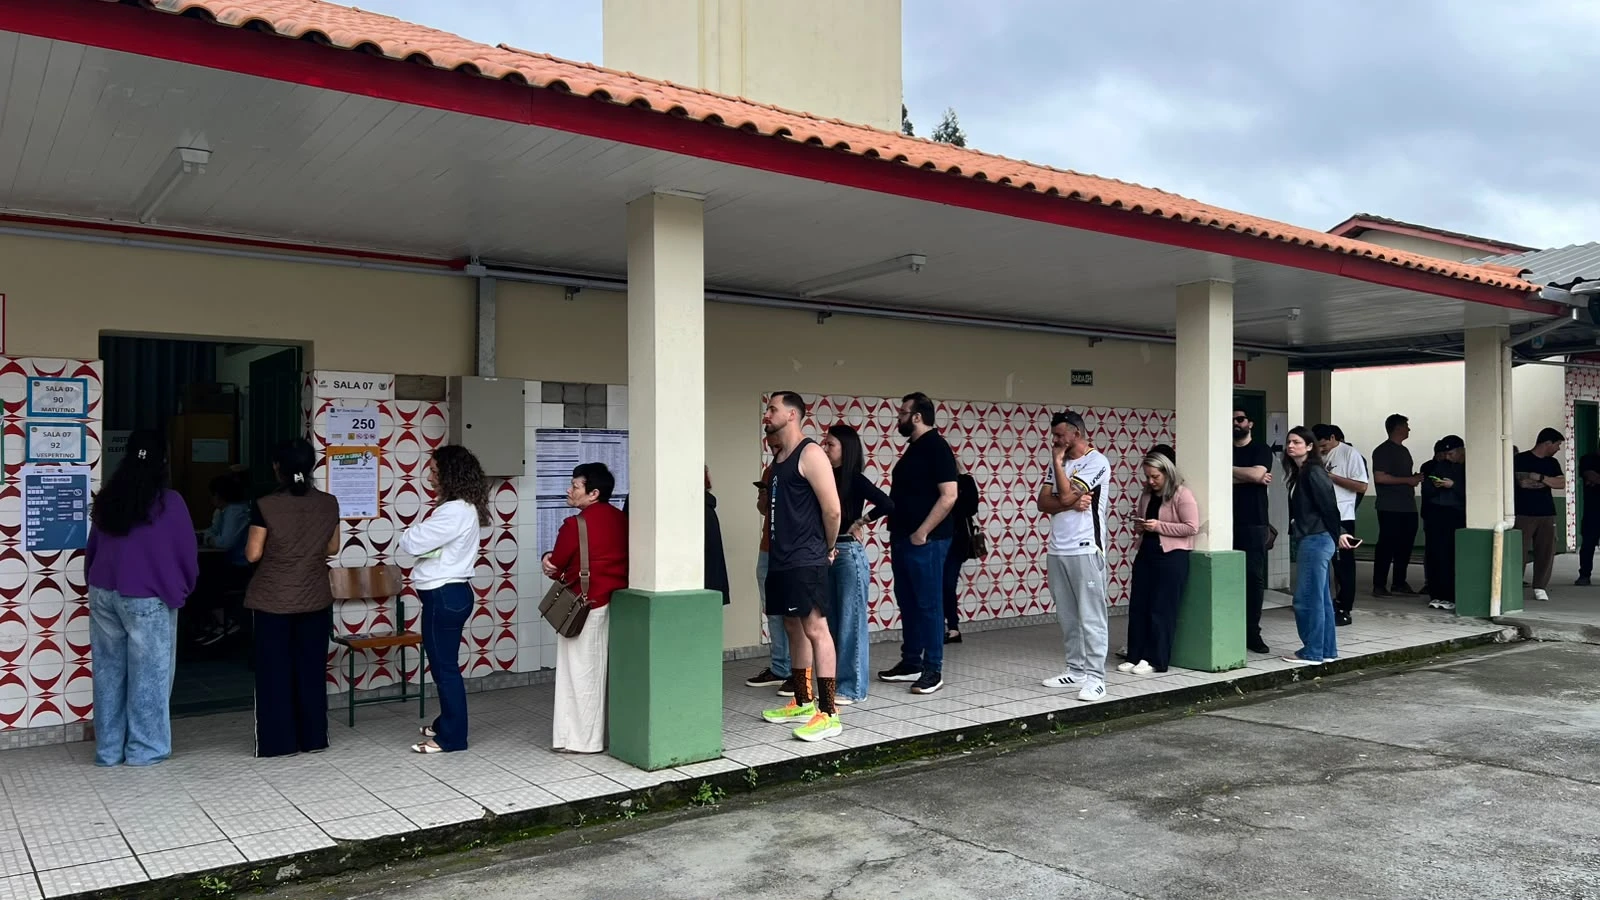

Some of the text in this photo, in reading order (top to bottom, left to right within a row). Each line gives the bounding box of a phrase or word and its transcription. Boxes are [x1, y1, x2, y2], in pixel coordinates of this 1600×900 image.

[333, 380, 361, 390] SALA
[362, 381, 374, 390] 07
[352, 418, 376, 430] 250
